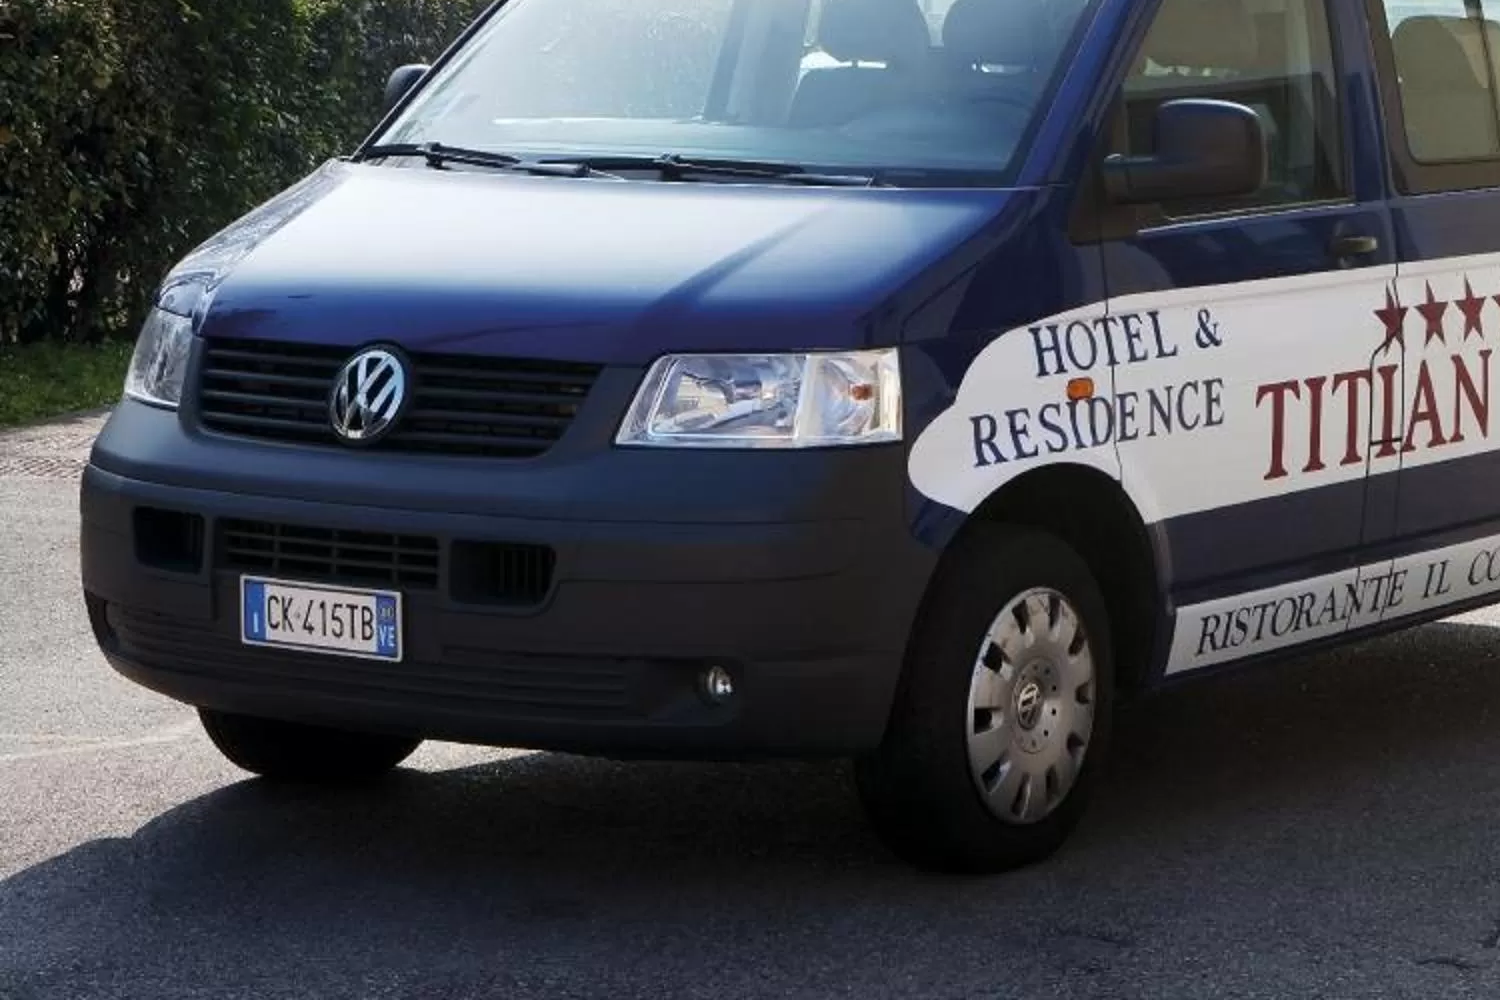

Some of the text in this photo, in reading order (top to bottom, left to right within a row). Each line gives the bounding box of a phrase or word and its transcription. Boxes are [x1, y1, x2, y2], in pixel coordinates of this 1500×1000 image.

[1028, 308, 1224, 377] HOTEL &
[970, 377, 1225, 467] RESIDENCE
[1255, 349, 1493, 481] TITIAN
[1195, 567, 1408, 656] RISTORANTE
[1422, 562, 1451, 598] IL
